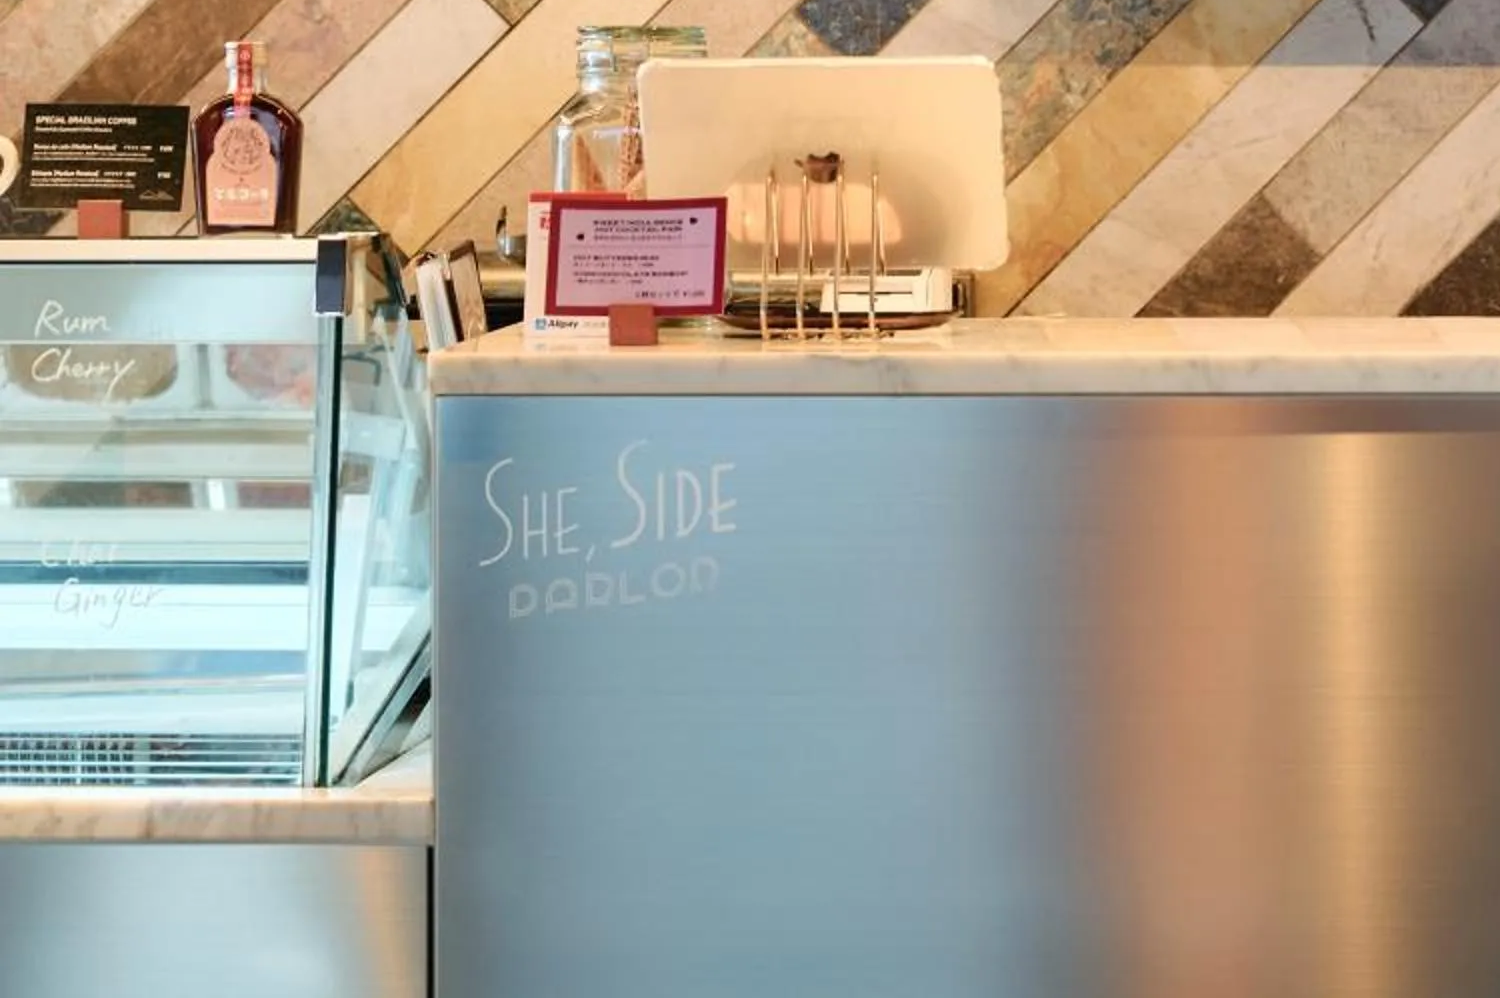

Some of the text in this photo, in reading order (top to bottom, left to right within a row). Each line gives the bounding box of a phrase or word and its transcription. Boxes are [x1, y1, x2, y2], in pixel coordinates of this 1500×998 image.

[34, 299, 112, 339] Rum
[547, 319, 579, 330] Alipay
[31, 347, 135, 404] Cherry
[610, 438, 738, 548] SIDE
[54, 577, 165, 632] Ginger
